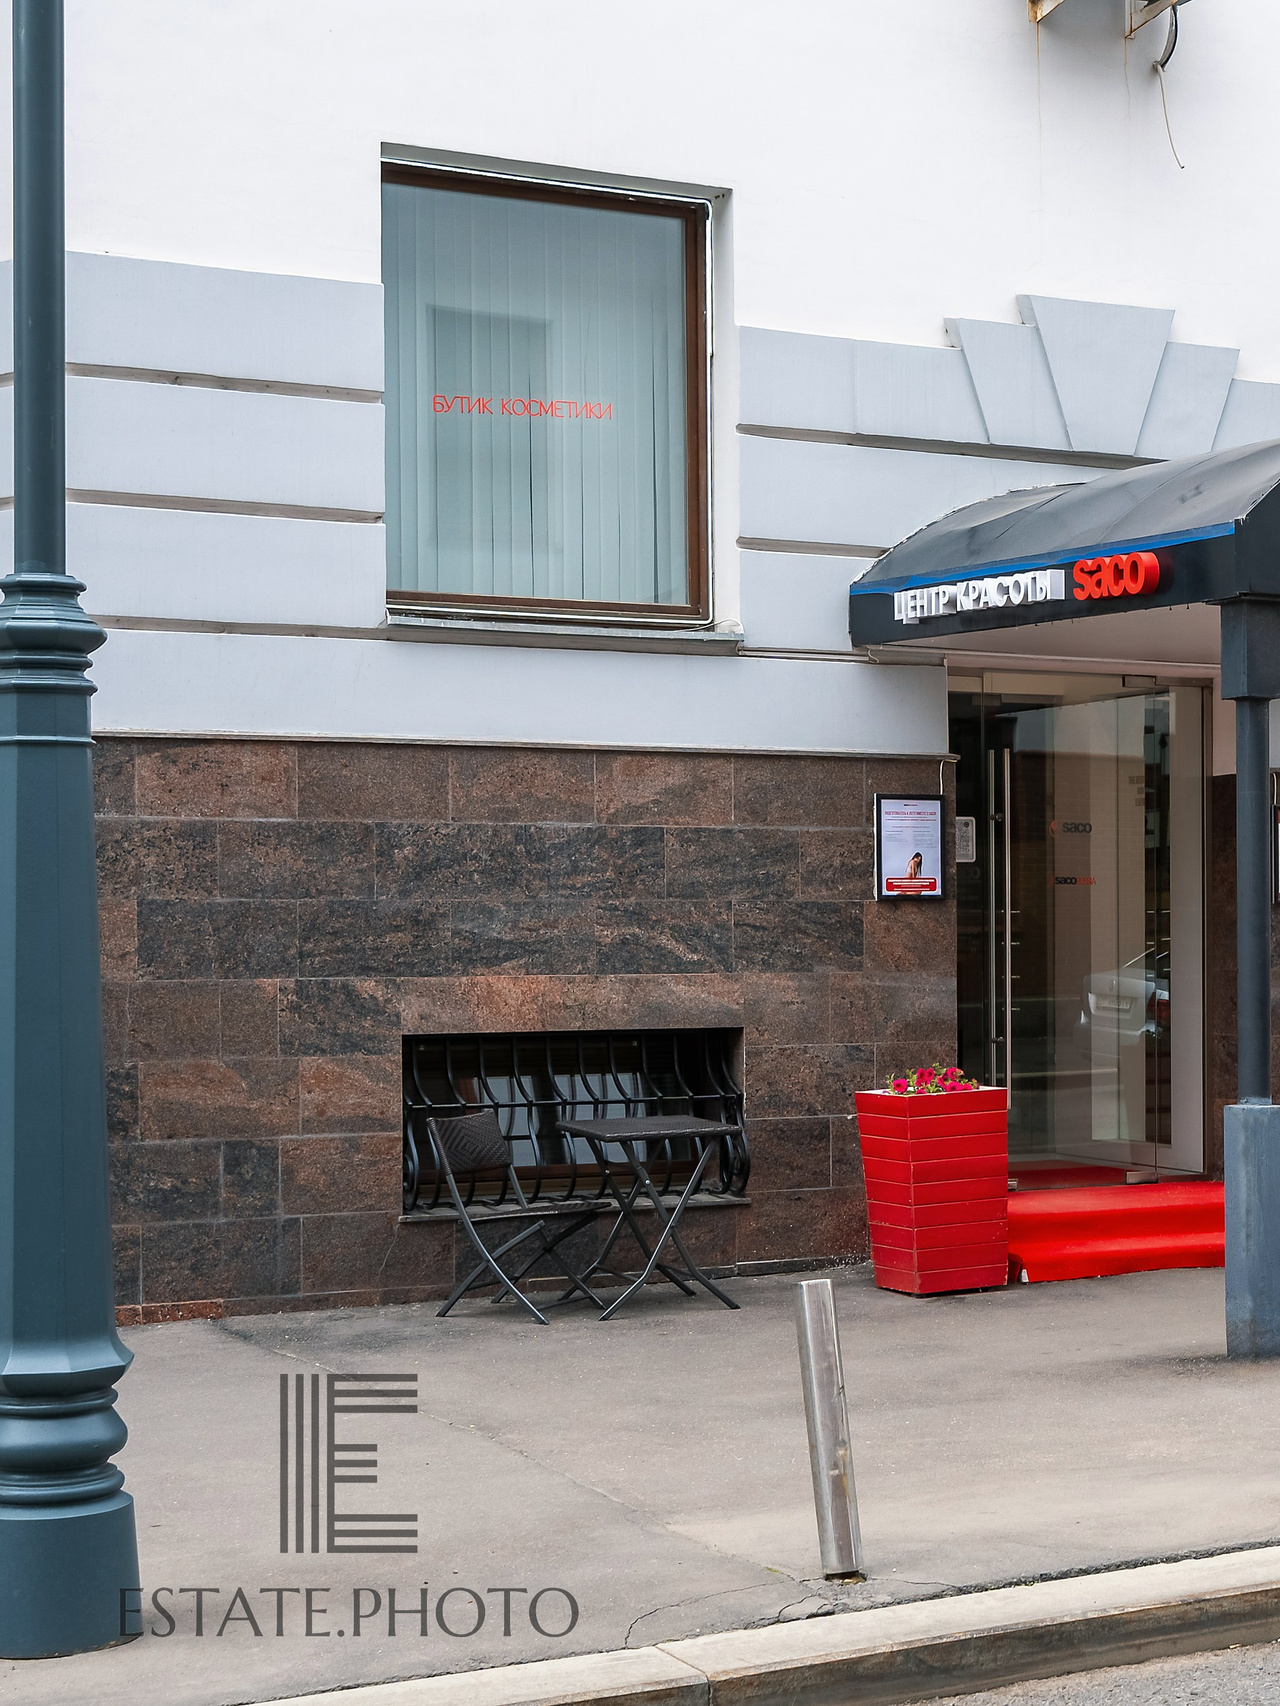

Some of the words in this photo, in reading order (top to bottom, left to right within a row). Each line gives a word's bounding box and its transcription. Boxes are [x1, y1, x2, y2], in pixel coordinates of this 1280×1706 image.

[433, 394, 493, 414] БУТИК
[501, 398, 612, 420] КОСМЕТИКИ
[1072, 551, 1160, 601] saco
[894, 585, 957, 625] ЦЕНТР
[957, 569, 1066, 612] КРАСОТЫ
[1062, 822, 1093, 834] saco
